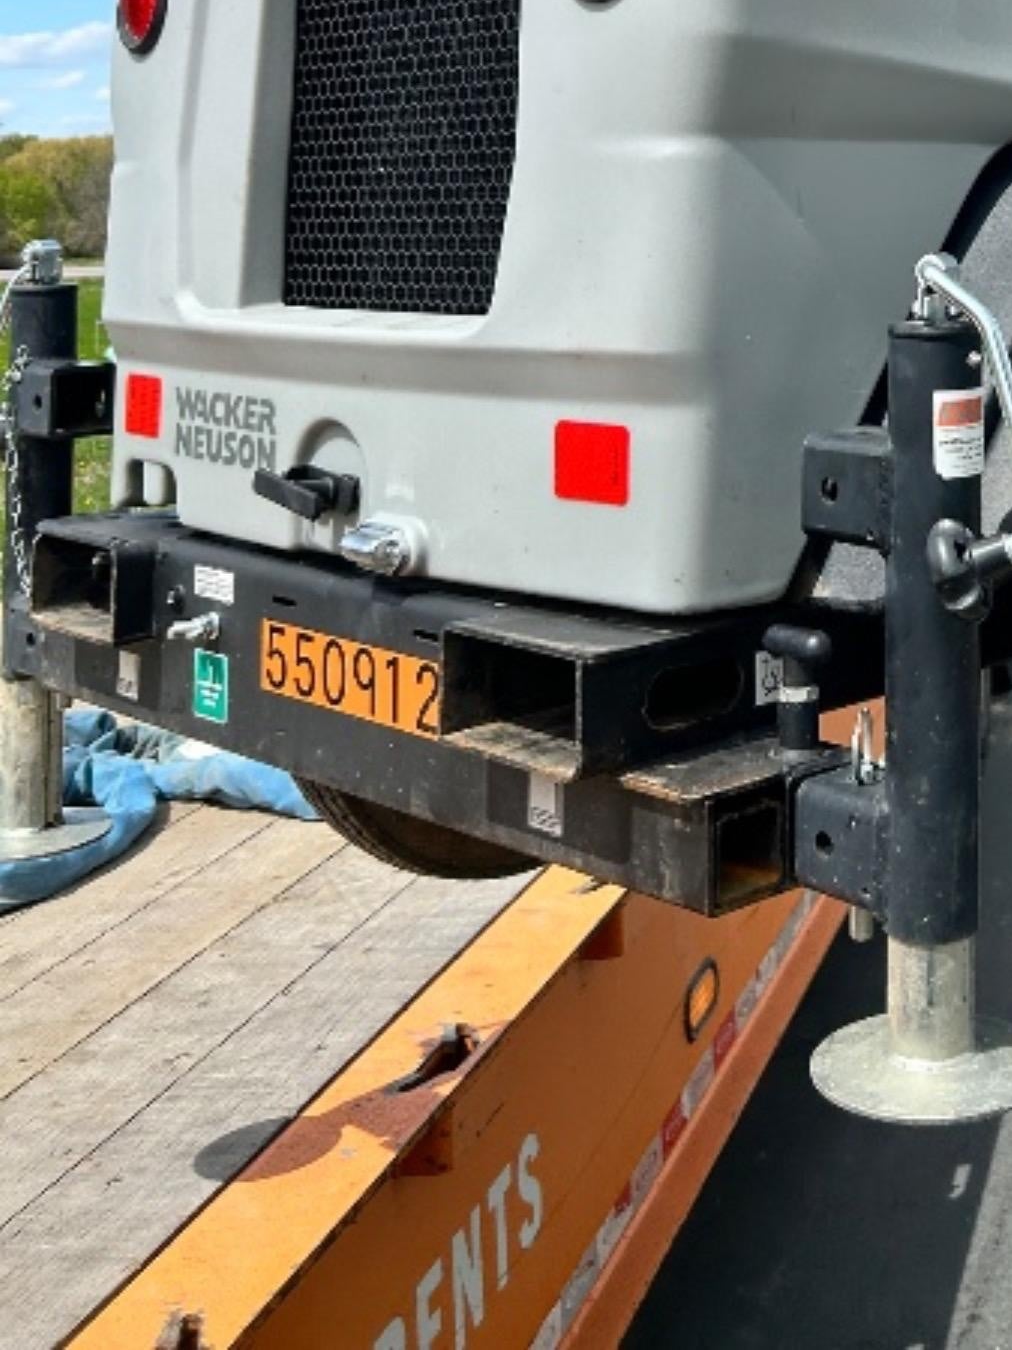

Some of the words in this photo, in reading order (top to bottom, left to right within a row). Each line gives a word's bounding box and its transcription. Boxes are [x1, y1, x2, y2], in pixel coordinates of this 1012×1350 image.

[175, 386, 276, 436] WACKER
[175, 422, 276, 471] NEUSON
[266, 624, 439, 734] 550912
